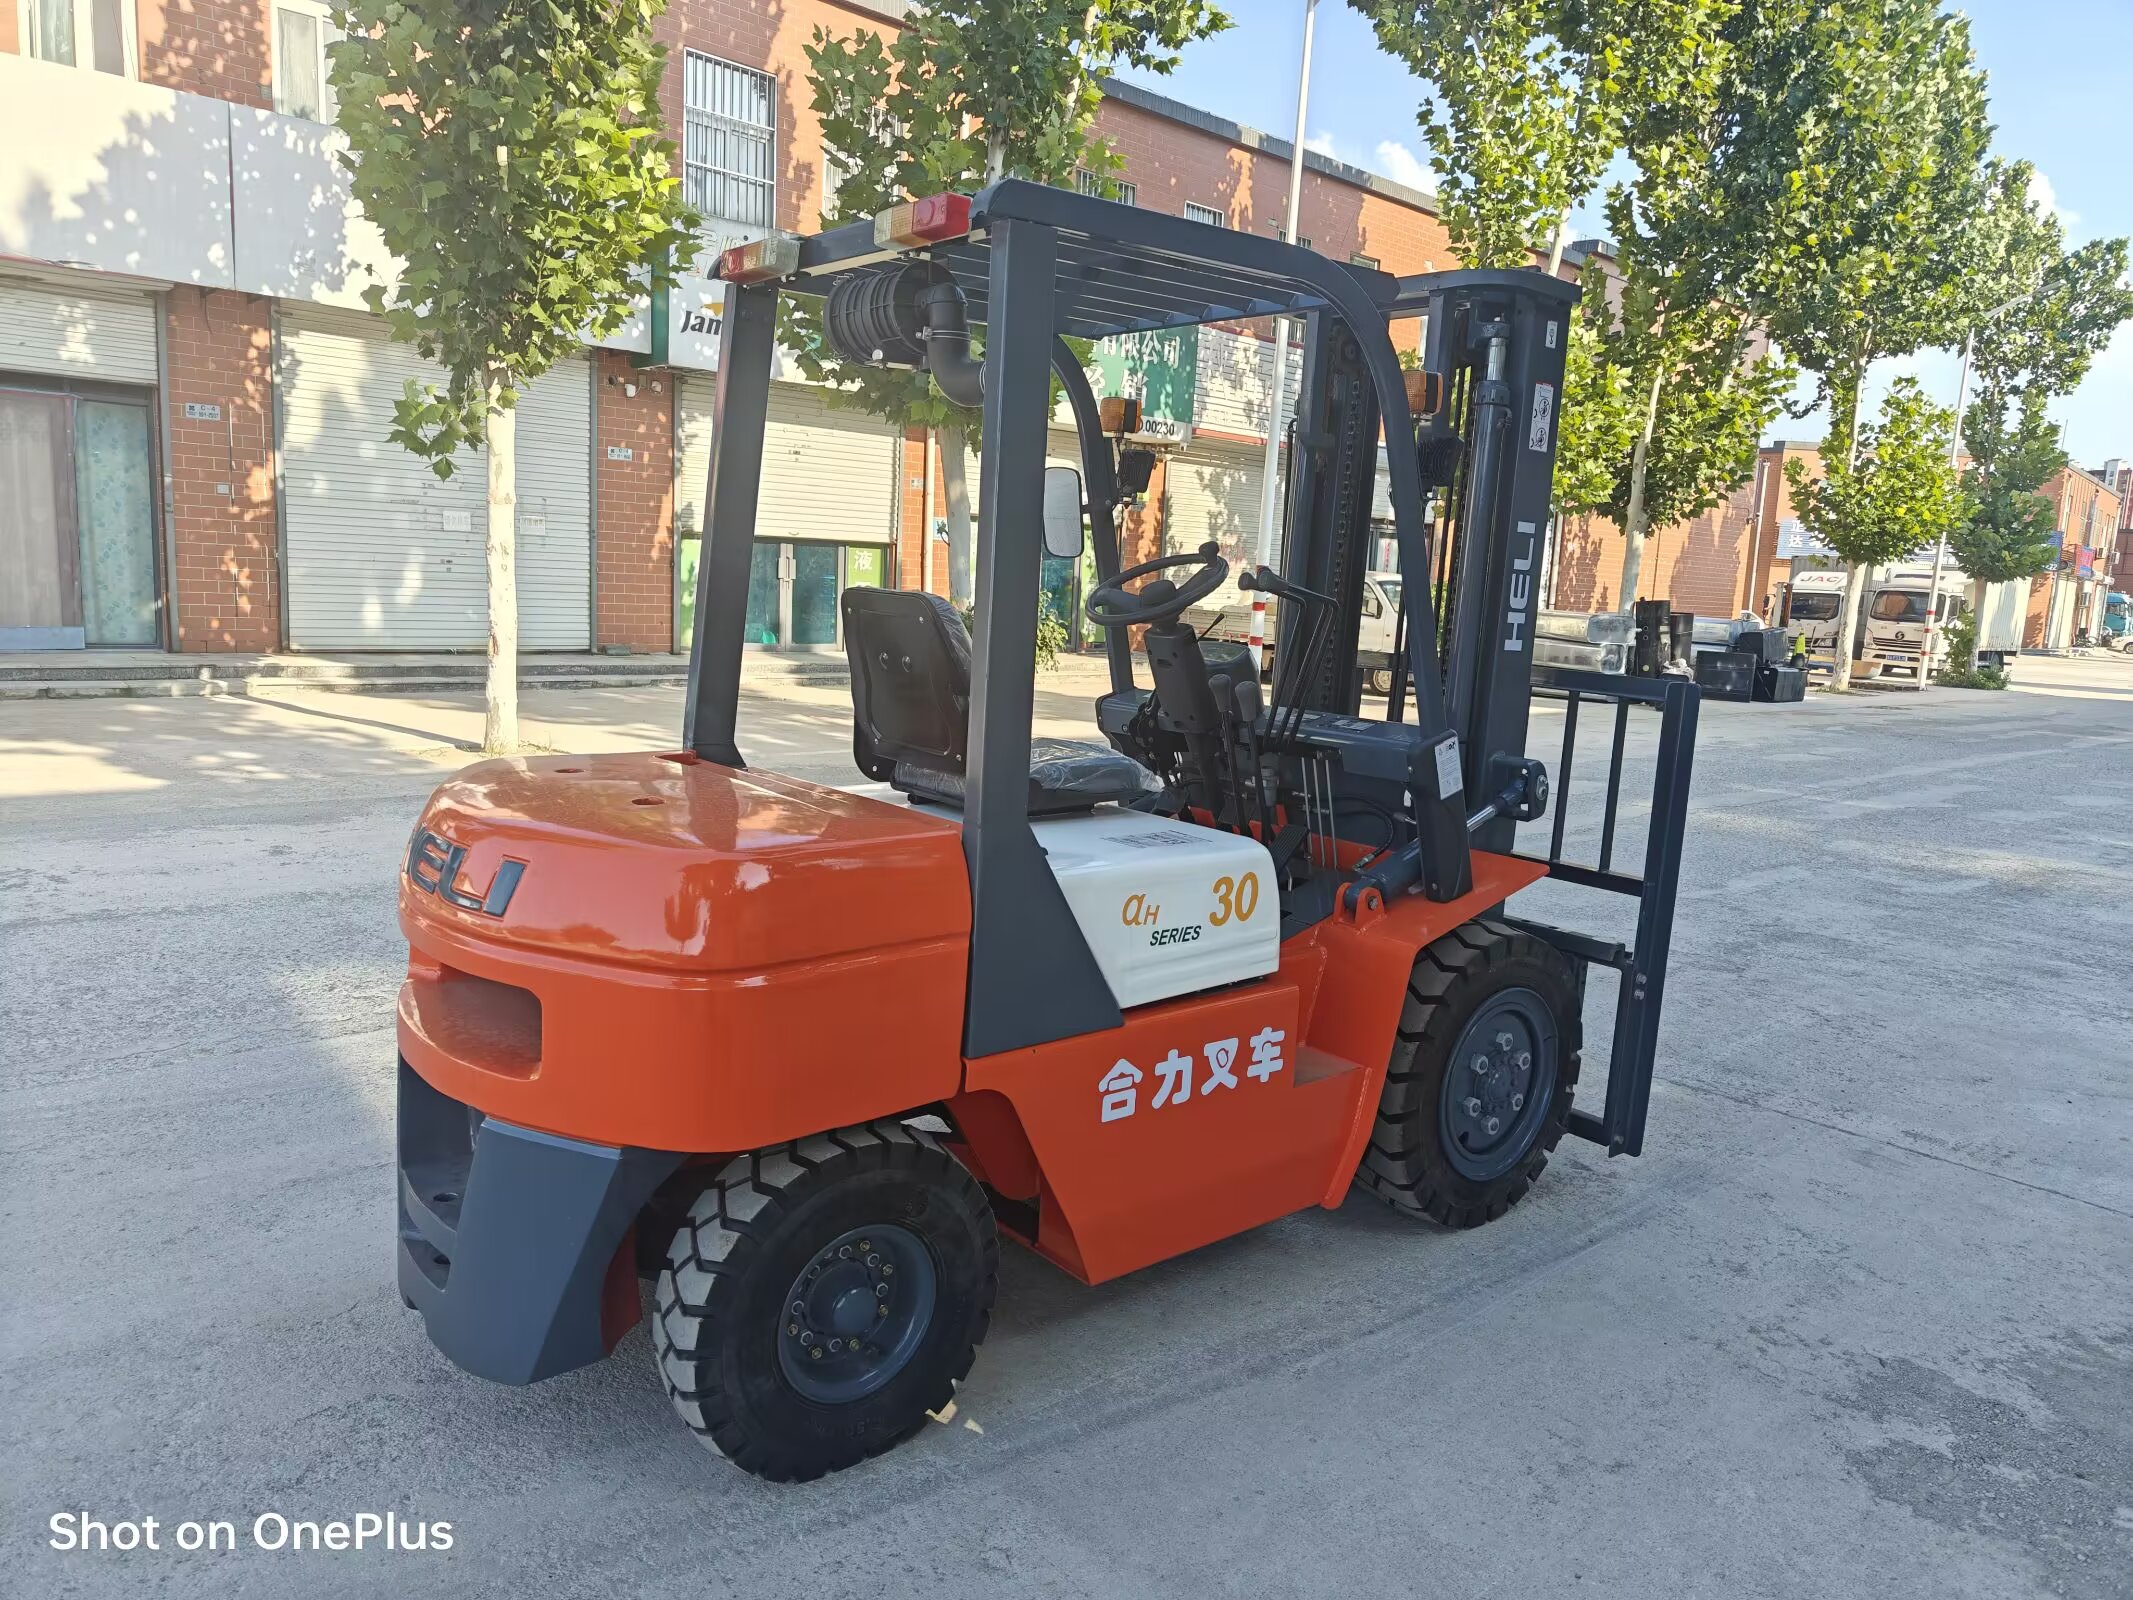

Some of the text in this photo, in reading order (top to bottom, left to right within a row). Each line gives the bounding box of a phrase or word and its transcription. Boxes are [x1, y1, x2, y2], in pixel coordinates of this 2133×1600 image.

[854, 550, 872, 571] 液
[1799, 575, 1841, 584] JAC
[1504, 521, 1536, 652] HELI
[1209, 871, 1259, 927] 30
[1149, 925, 1202, 946] SERIES
[1098, 1027, 1285, 1123] 合力叉车
